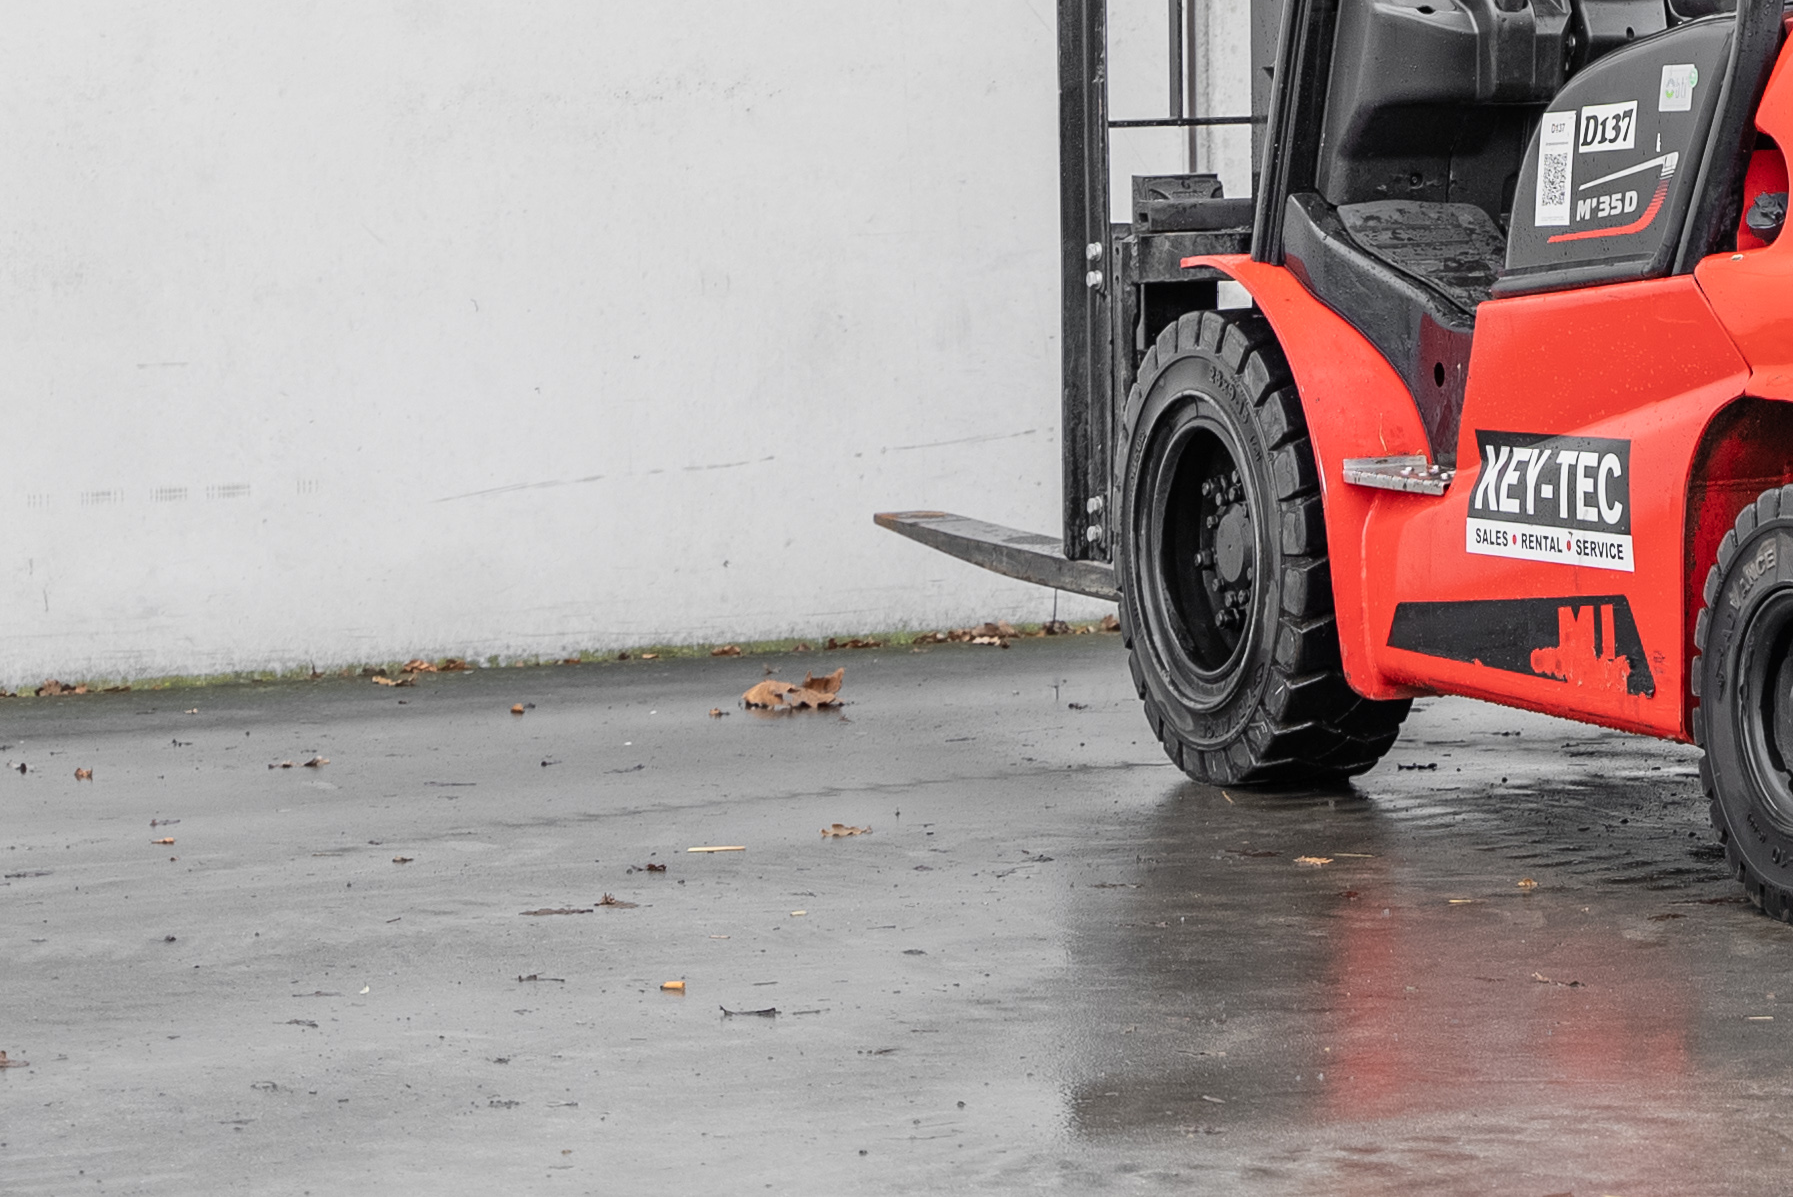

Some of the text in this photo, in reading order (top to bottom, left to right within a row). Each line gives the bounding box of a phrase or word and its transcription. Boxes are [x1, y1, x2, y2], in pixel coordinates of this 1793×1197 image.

[1581, 108, 1634, 147] D137
[1474, 444, 1624, 525] KEY-TEC
[1475, 527, 1625, 561] SALES RENTAL SERVICE
